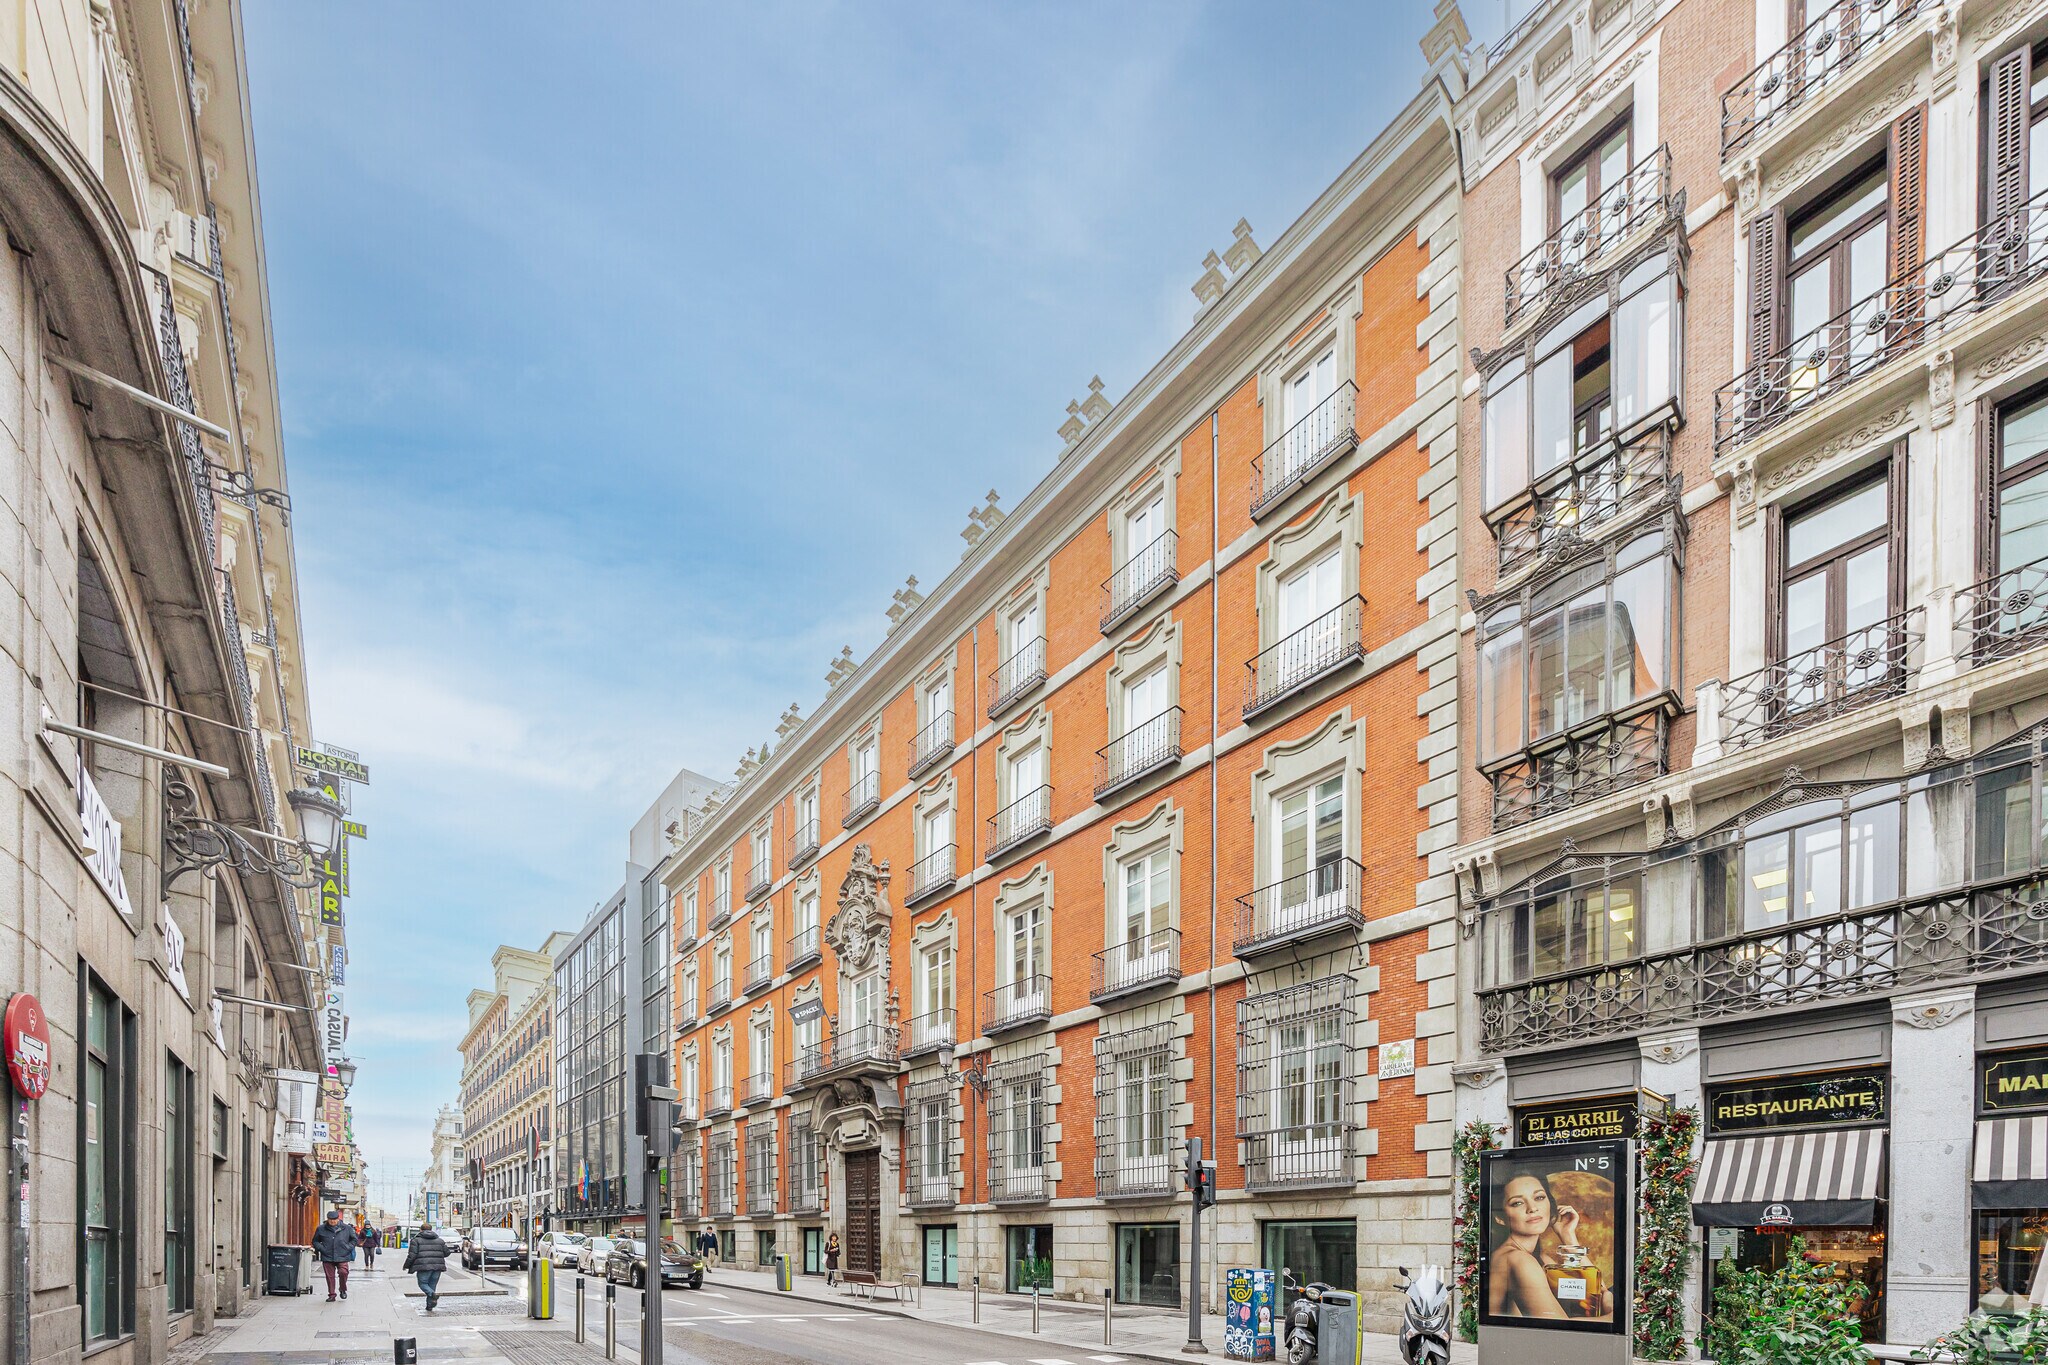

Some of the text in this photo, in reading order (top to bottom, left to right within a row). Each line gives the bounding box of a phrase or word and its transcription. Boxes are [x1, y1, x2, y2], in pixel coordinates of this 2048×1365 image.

[299, 748, 367, 776] HOSTAL
[327, 746, 358, 762] ASTORIA
[343, 820, 366, 836] TAL
[322, 784, 341, 914] ALAR
[327, 1008, 341, 1052] CASUAL
[1380, 1062, 1406, 1071] CARRERA
[325, 1079, 342, 1143] TRRON
[1718, 1091, 1875, 1119] RESTAURANTE
[1529, 1110, 1625, 1131] EL BARRIL
[1528, 1124, 1623, 1142] DE LAS CORTES
[320, 1144, 347, 1153] CASA
[319, 1153, 347, 1163] MIRA
[1598, 1156, 1610, 1169] 5
